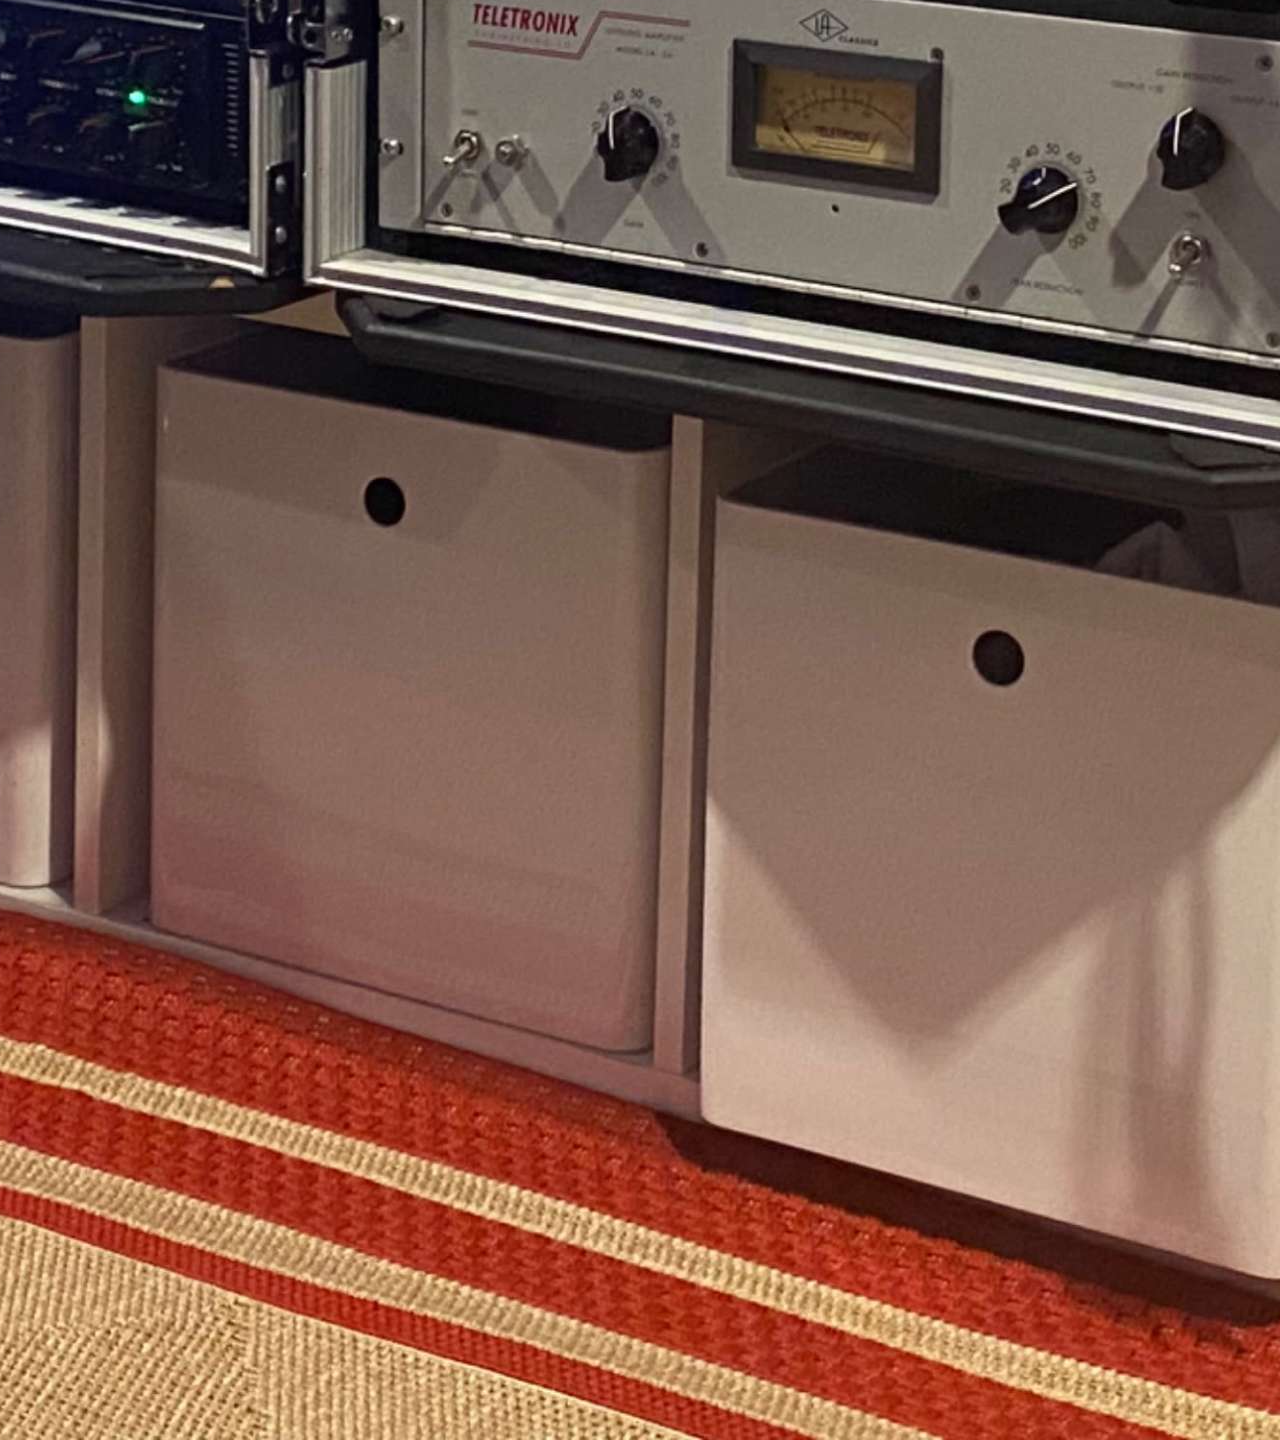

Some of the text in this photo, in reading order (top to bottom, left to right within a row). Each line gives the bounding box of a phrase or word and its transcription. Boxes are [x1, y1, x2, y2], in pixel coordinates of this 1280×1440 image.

[472, 2, 580, 38] TELETRONIX
[630, 87, 644, 100] 50
[1025, 143, 1039, 159] 40
[1044, 141, 1061, 156] 50
[1006, 156, 1022, 173] 30
[1066, 150, 1083, 167] 60
[1084, 169, 1098, 185] 70
